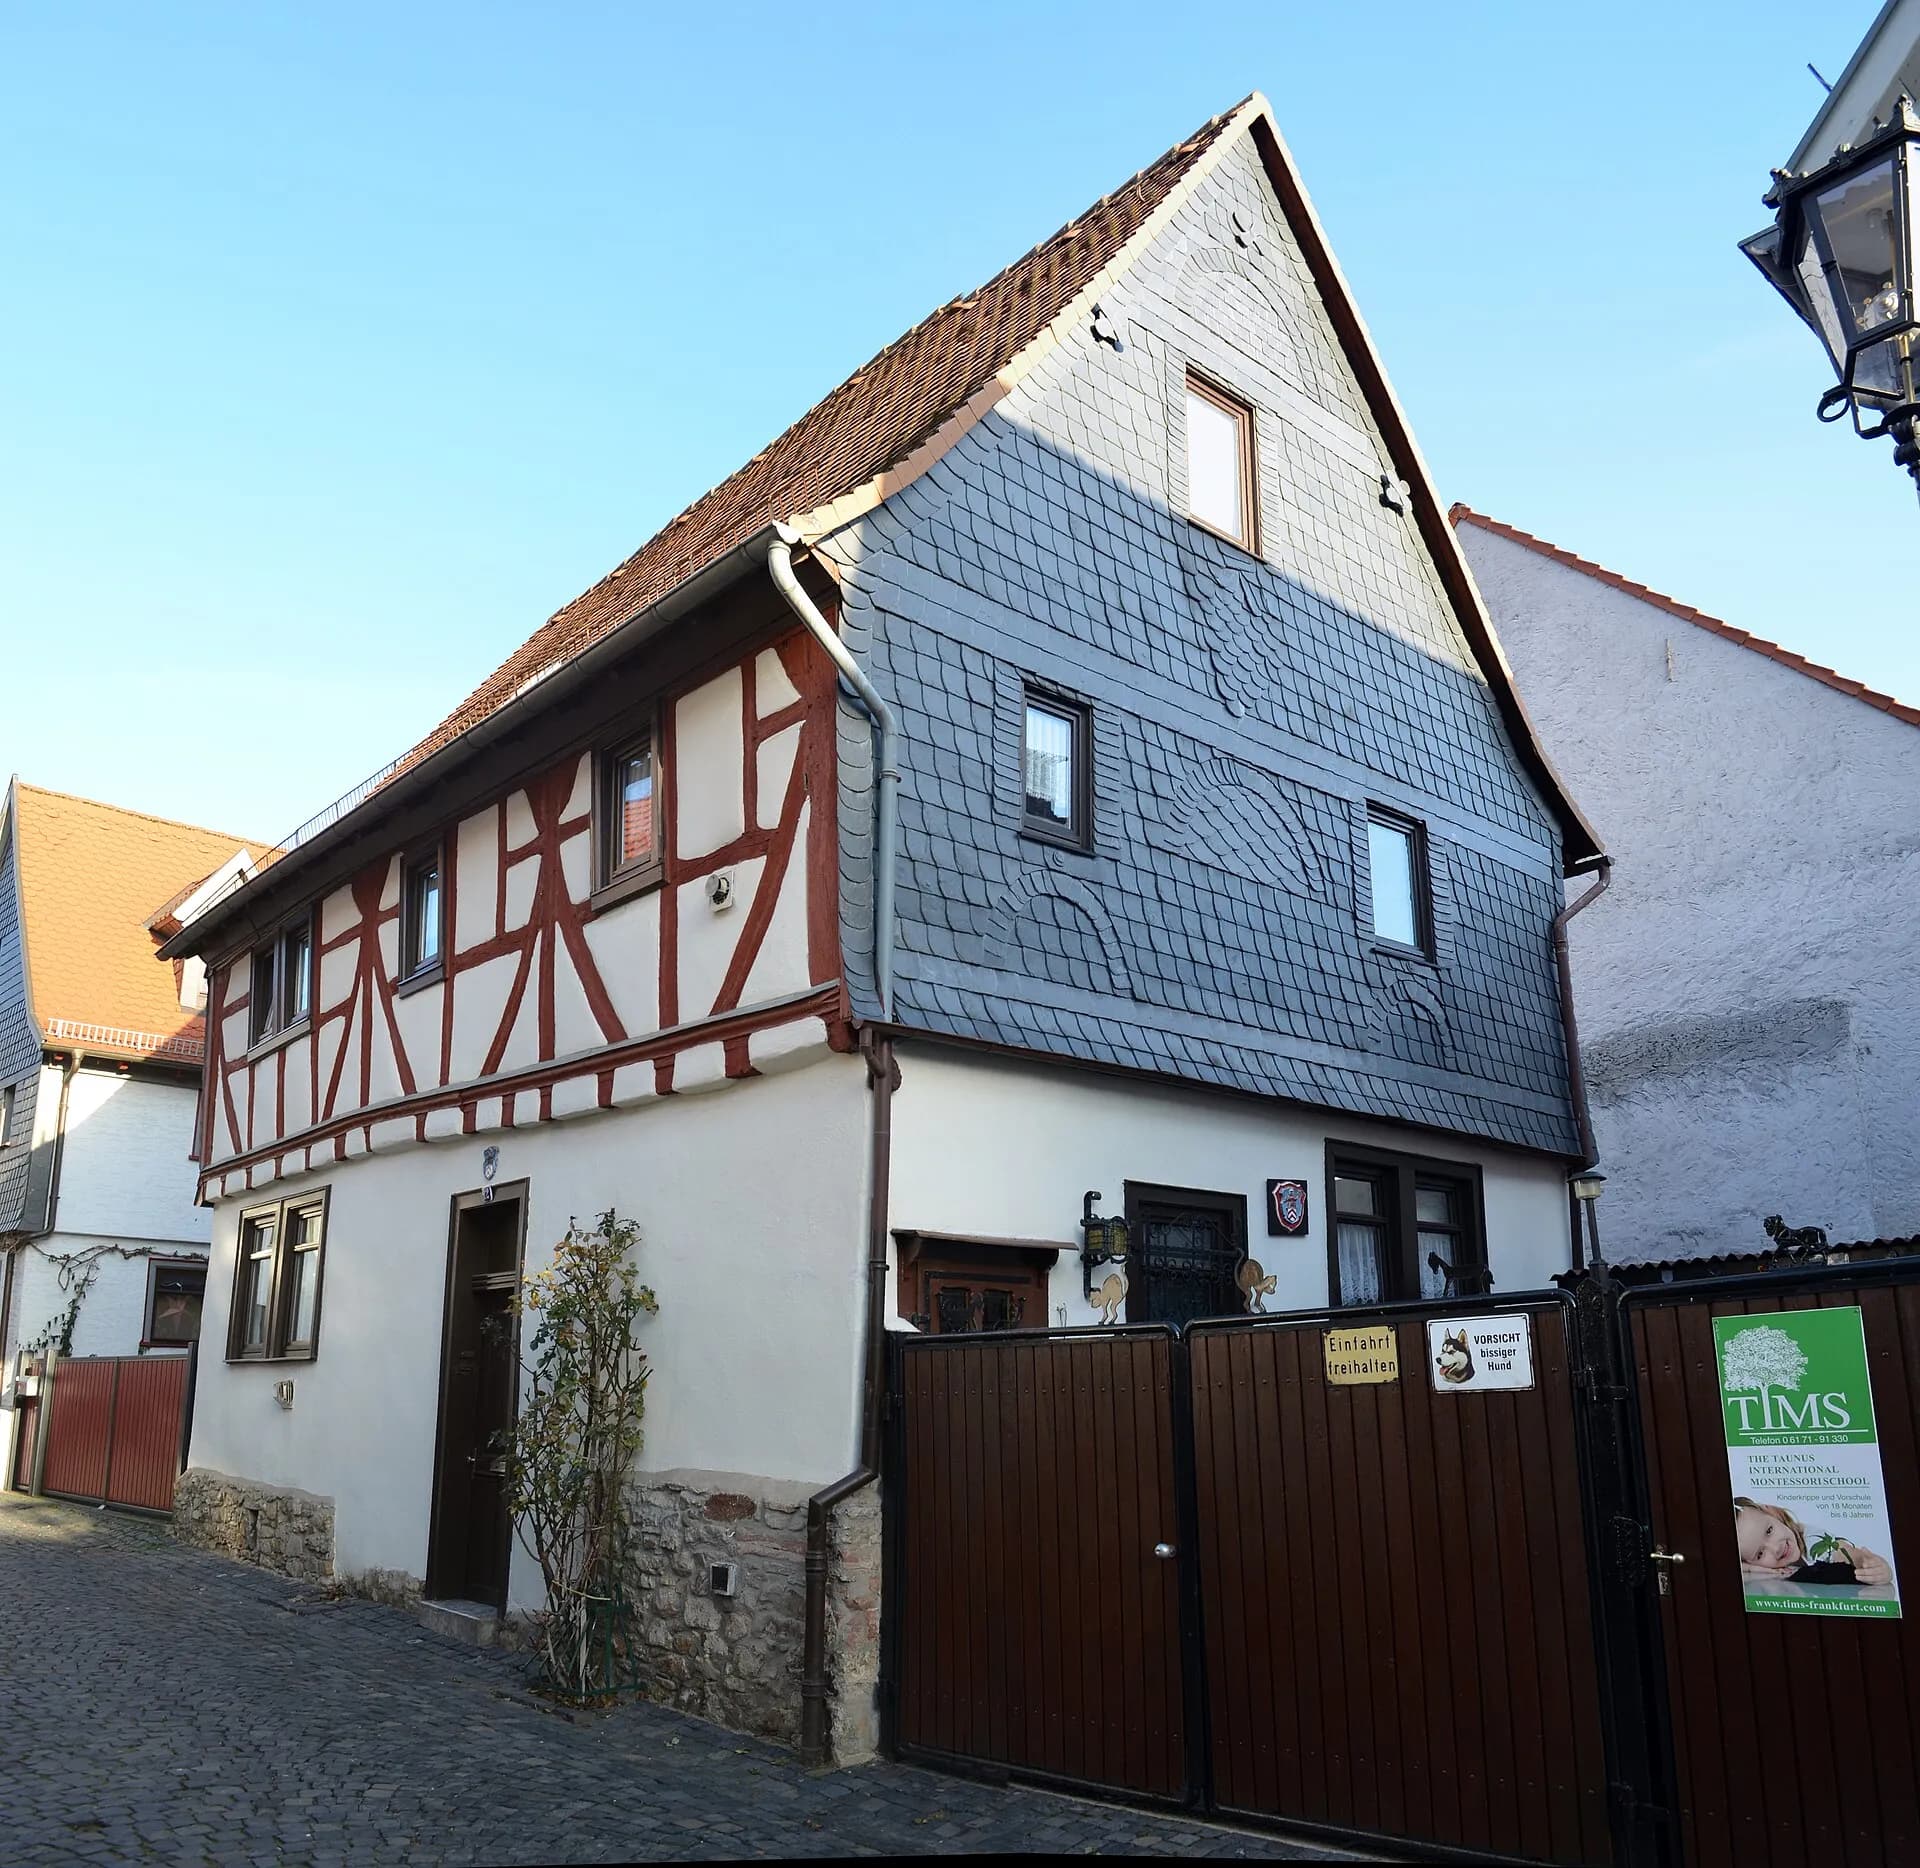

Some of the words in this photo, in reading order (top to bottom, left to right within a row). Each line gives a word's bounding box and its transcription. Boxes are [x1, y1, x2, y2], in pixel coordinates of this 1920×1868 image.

[1329, 1335, 1390, 1351] Einfahrt
[1474, 1332, 1521, 1344] VORSICHT
[1480, 1348, 1517, 1358] bissiger
[1328, 1359, 1396, 1375] freihalten
[1487, 1361, 1512, 1371] Hund
[1728, 1392, 1851, 1430] TIMS
[1750, 1436, 1780, 1445] Telefon
[1831, 1434, 1848, 1443] 330
[1747, 1455, 1769, 1463] THE
[1772, 1454, 1815, 1463] TAUNUS
[1749, 1465, 1840, 1474] INTERNATIONAL
[1776, 1494, 1820, 1502] Kinderkrippe
[1822, 1493, 1835, 1501] und
[1836, 1493, 1871, 1501] Vorschule
[1755, 1600, 1887, 1613] www.tims-frankfurt.com
